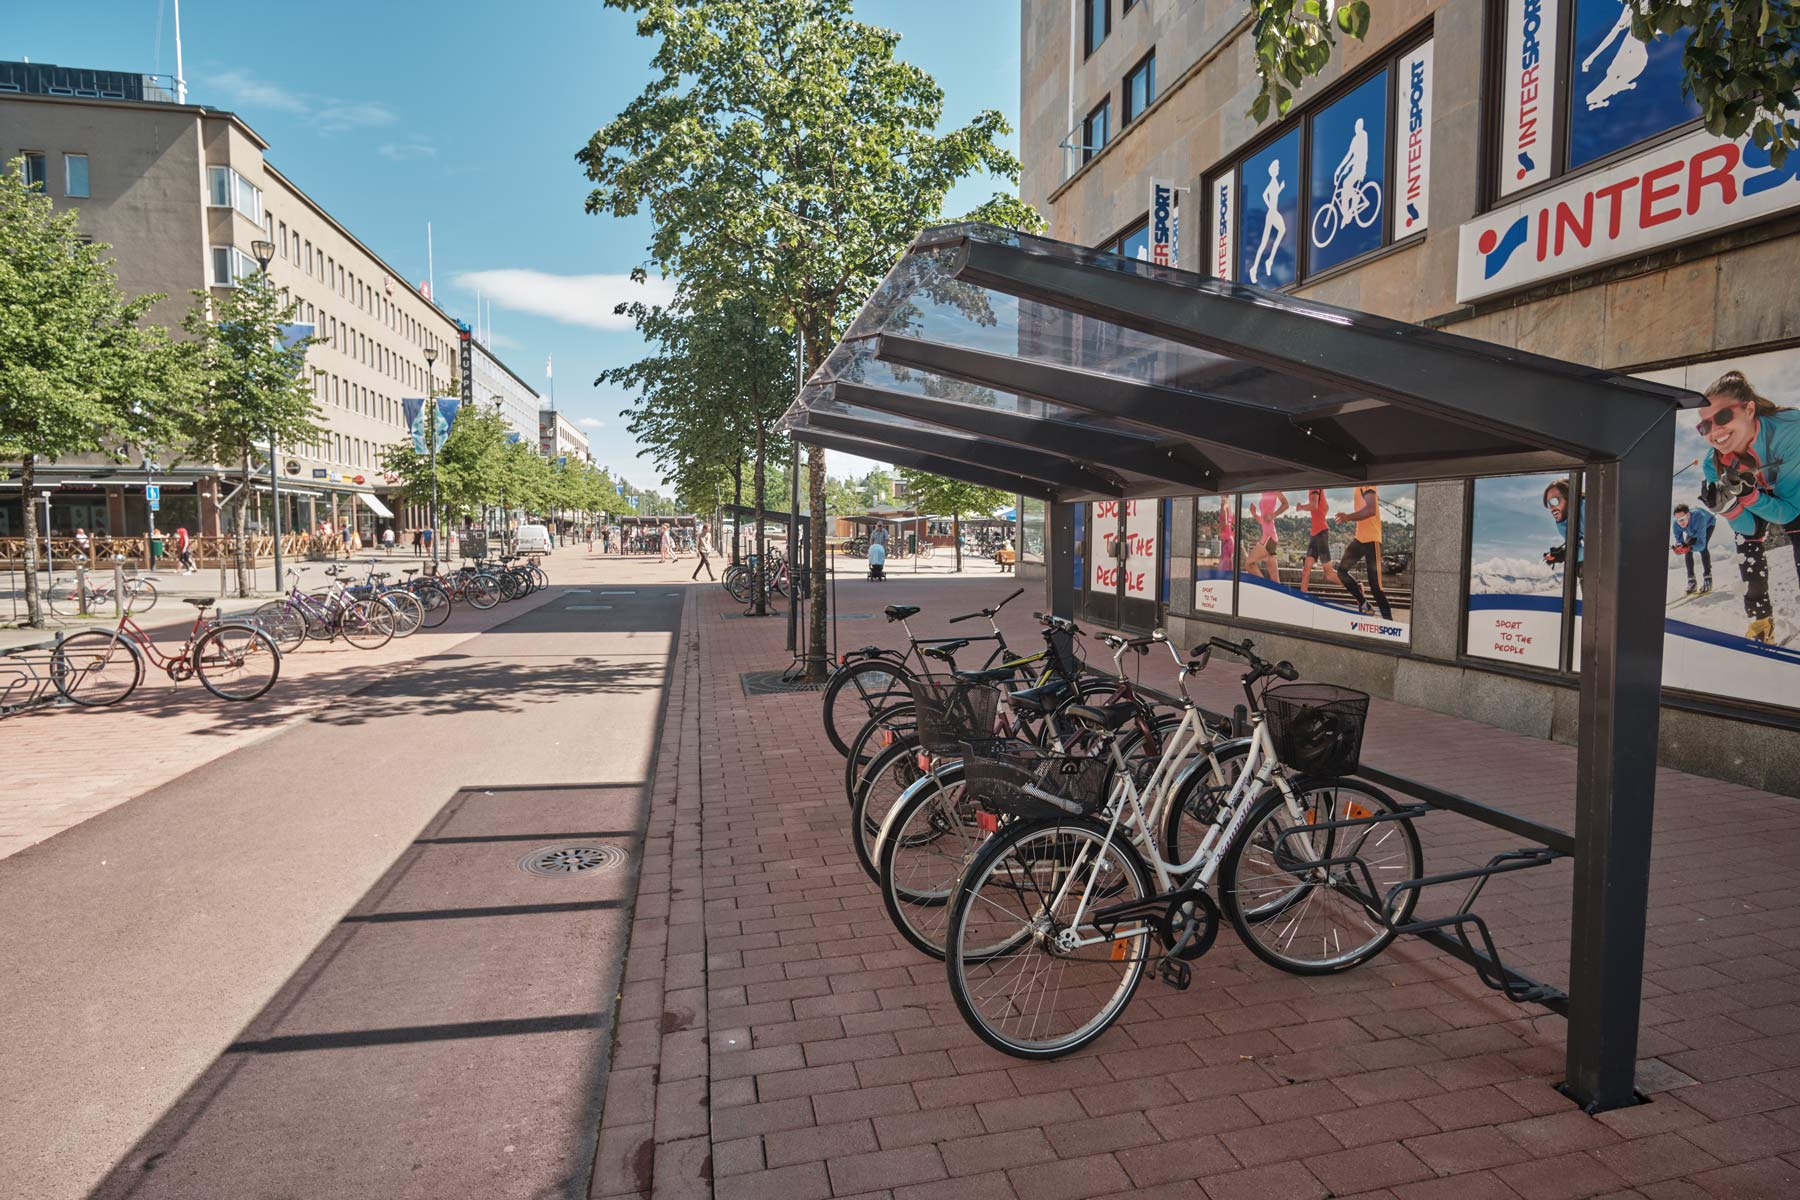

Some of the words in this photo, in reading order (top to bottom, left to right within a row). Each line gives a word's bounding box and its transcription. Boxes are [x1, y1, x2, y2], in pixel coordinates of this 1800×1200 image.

[1407, 60, 1424, 200] INTERSPORT
[1536, 118, 1800, 262] INTERS
[1103, 533, 1119, 553] T
[1126, 533, 1154, 556] THE
[1358, 623, 1402, 636] INTERSPORT
[1495, 620, 1522, 629] SPORT
[1500, 632, 1512, 640] TO
[1515, 634, 1532, 644] THE
[1494, 643, 1525, 654] PEOPLE
